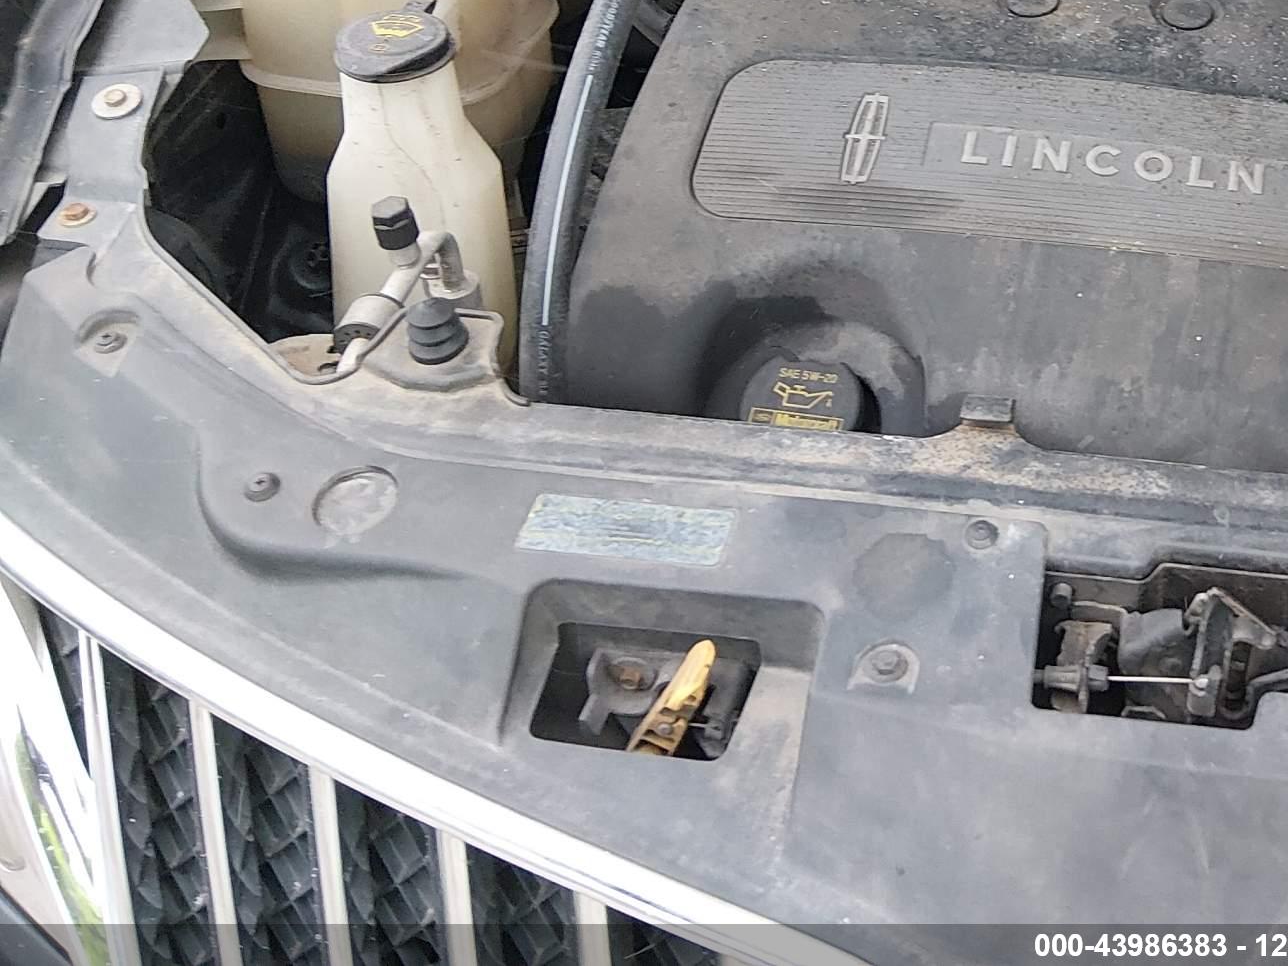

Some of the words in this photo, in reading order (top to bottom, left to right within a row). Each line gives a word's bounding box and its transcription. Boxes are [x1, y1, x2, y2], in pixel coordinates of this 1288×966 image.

[960, 130, 1265, 195] LINCOLN
[779, 367, 801, 379] SAE
[801, 370, 839, 384] 5W-20
